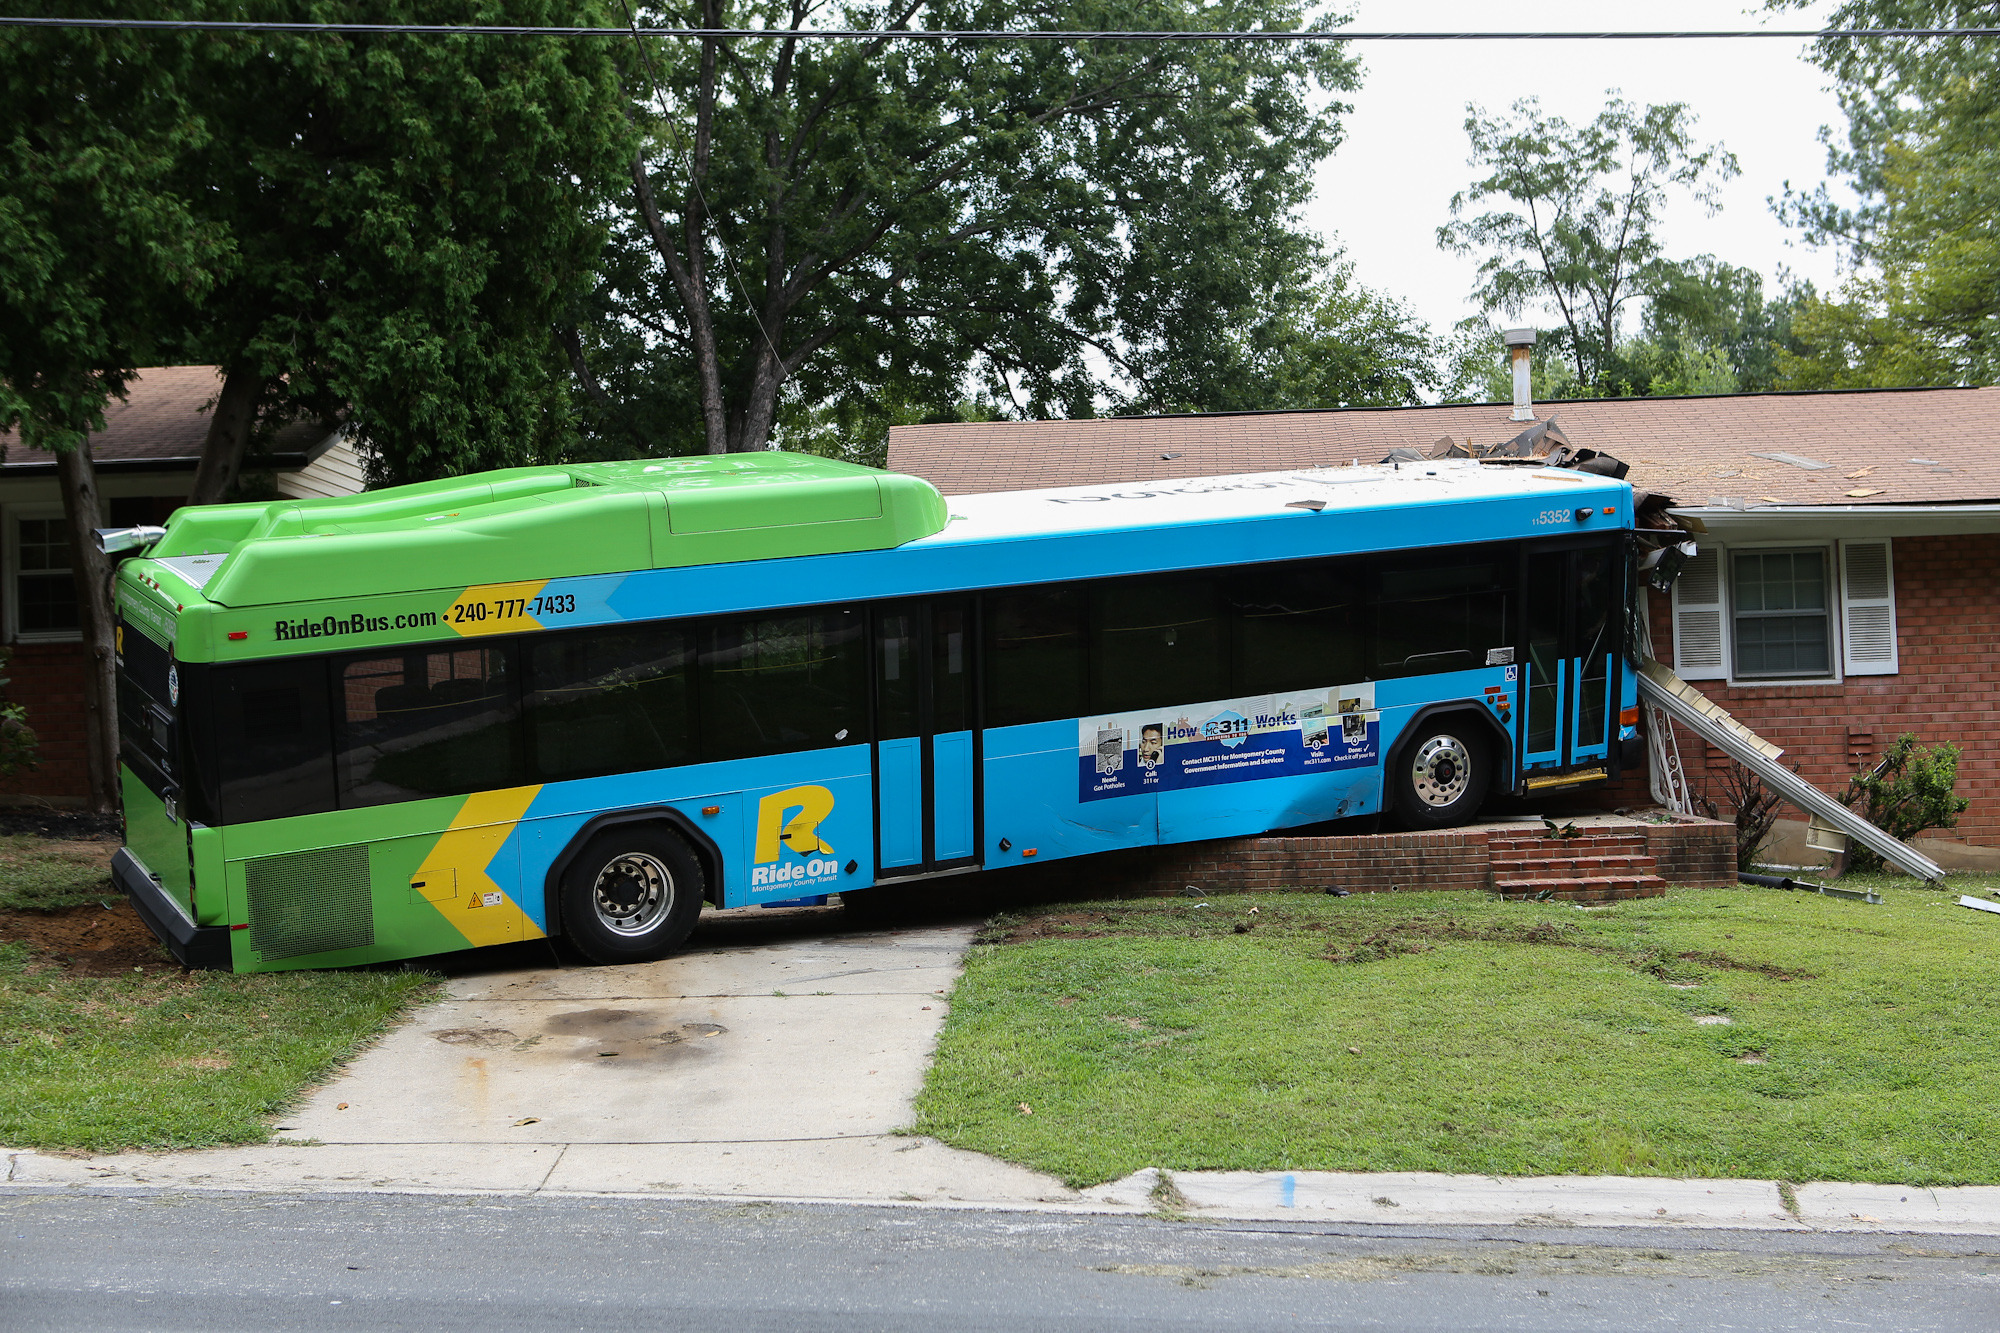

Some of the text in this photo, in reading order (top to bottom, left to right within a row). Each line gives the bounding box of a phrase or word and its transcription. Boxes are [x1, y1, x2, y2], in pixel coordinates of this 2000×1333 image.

[275, 594, 576, 640] RideOnBus.com 240-777-7433
[1167, 726, 1198, 739] How
[1255, 712, 1297, 728] Works
[1182, 758, 1202, 766] Contact
[1203, 755, 1220, 763] MC311
[1229, 750, 1265, 760] Montgomery
[1265, 748, 1286, 756] County
[1184, 765, 1217, 774] Government
[1217, 761, 1249, 770] Information
[1261, 757, 1284, 765] Services
[1104, 782, 1125, 790] Potholes
[754, 785, 835, 865] R
[752, 858, 838, 886] Ride On
[752, 874, 838, 892] Montgomery County Transit
